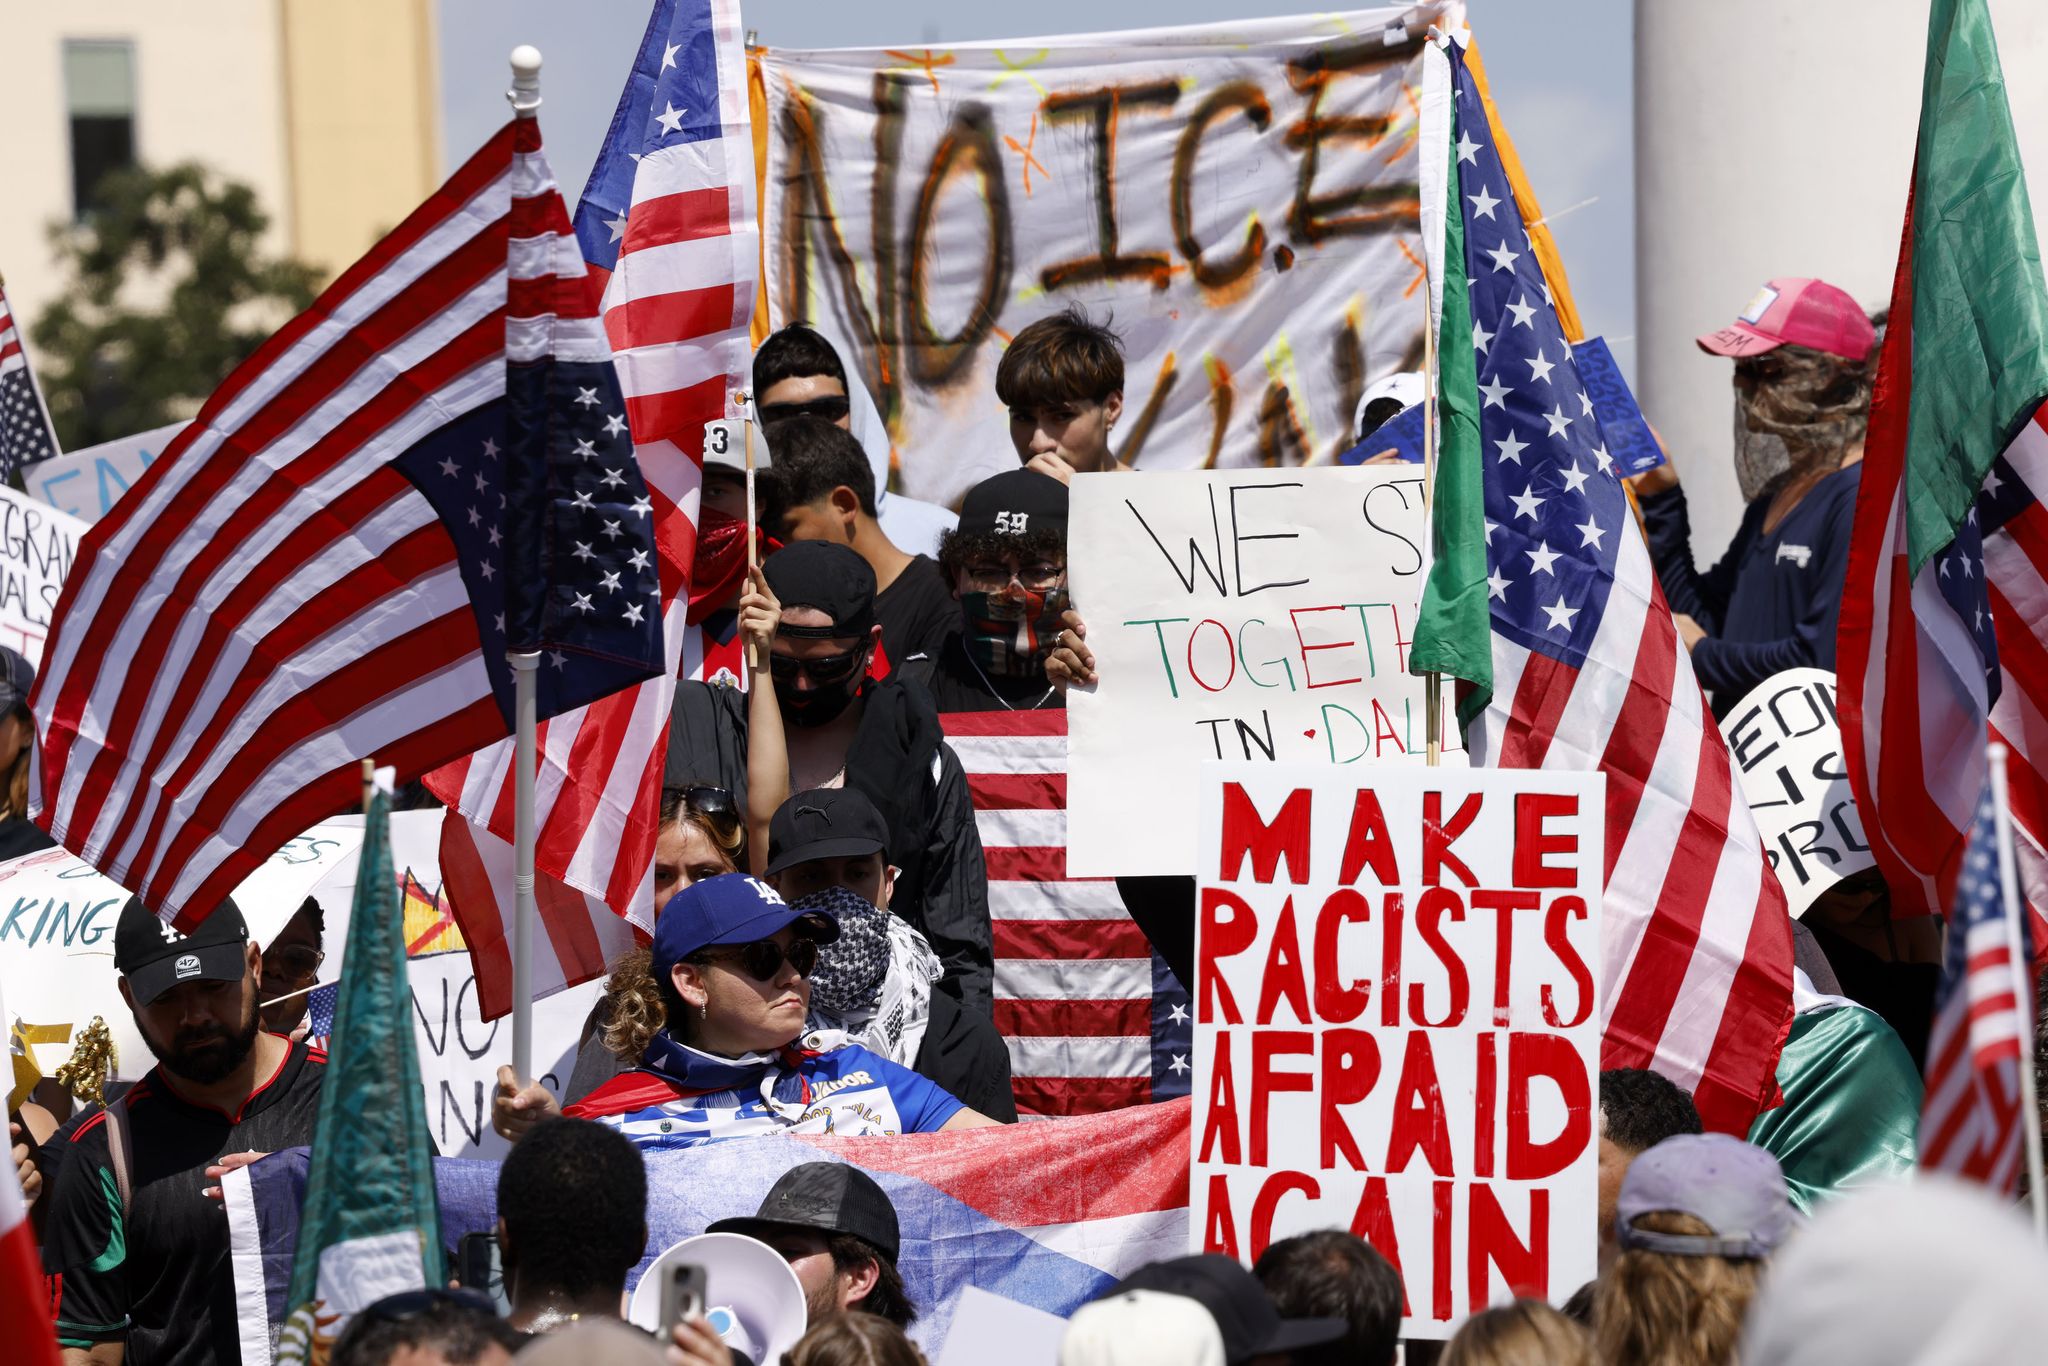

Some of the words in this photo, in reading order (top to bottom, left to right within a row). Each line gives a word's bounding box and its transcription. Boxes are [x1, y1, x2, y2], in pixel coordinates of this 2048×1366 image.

[778, 68, 1014, 430] NO
[704, 426, 728, 454] 3
[994, 511, 1029, 535] 59
[1125, 483, 1310, 597] WE
[1219, 782, 1579, 888] MAKE
[0, 896, 120, 949] KING
[743, 877, 786, 906] LA
[1198, 886, 1595, 1028] RACISTS
[1197, 1028, 1592, 1181] AFRAID
